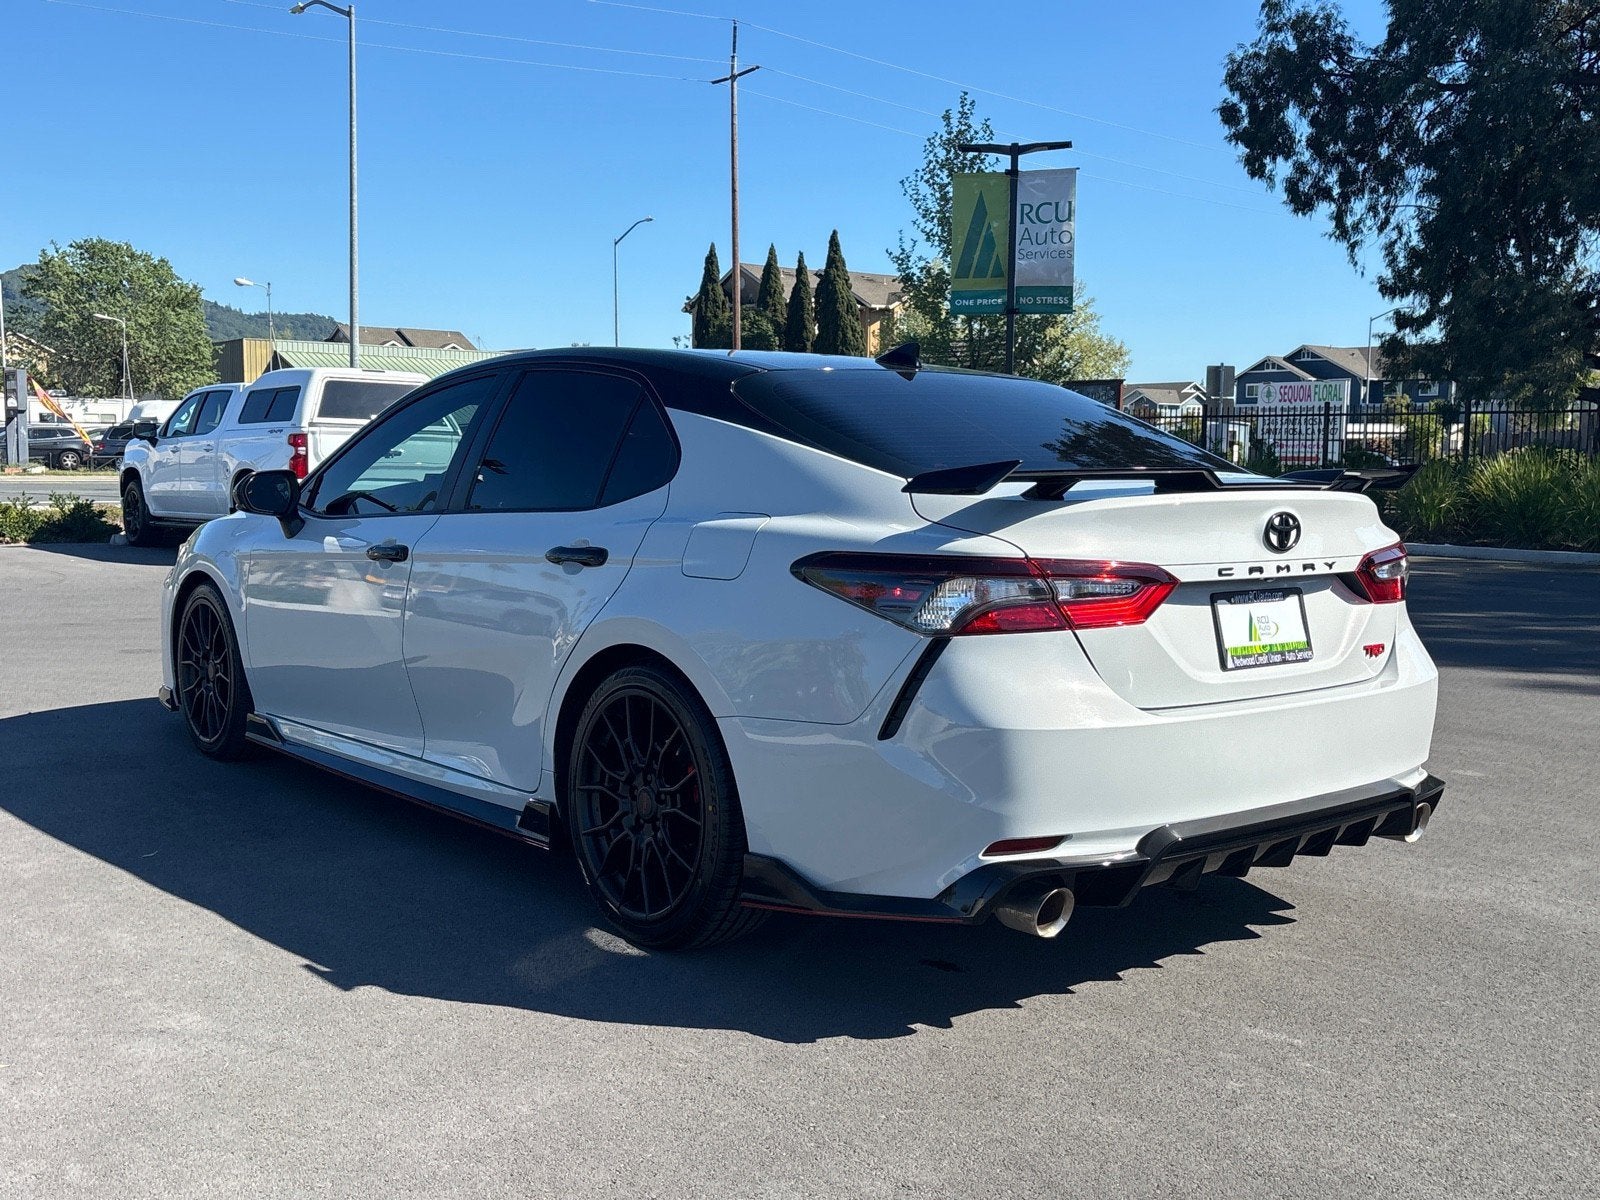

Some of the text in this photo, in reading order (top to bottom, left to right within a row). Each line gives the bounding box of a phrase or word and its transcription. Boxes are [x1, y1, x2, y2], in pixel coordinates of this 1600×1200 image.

[1019, 201, 1073, 225] RCU
[1018, 227, 1073, 246] Auto
[1017, 248, 1073, 260] Services
[976, 298, 1003, 306] PRICE
[1019, 296, 1069, 304] NO STRESS
[1279, 384, 1342, 404] SEQUOIA FLORAL
[1217, 561, 1336, 577] CAMRY
